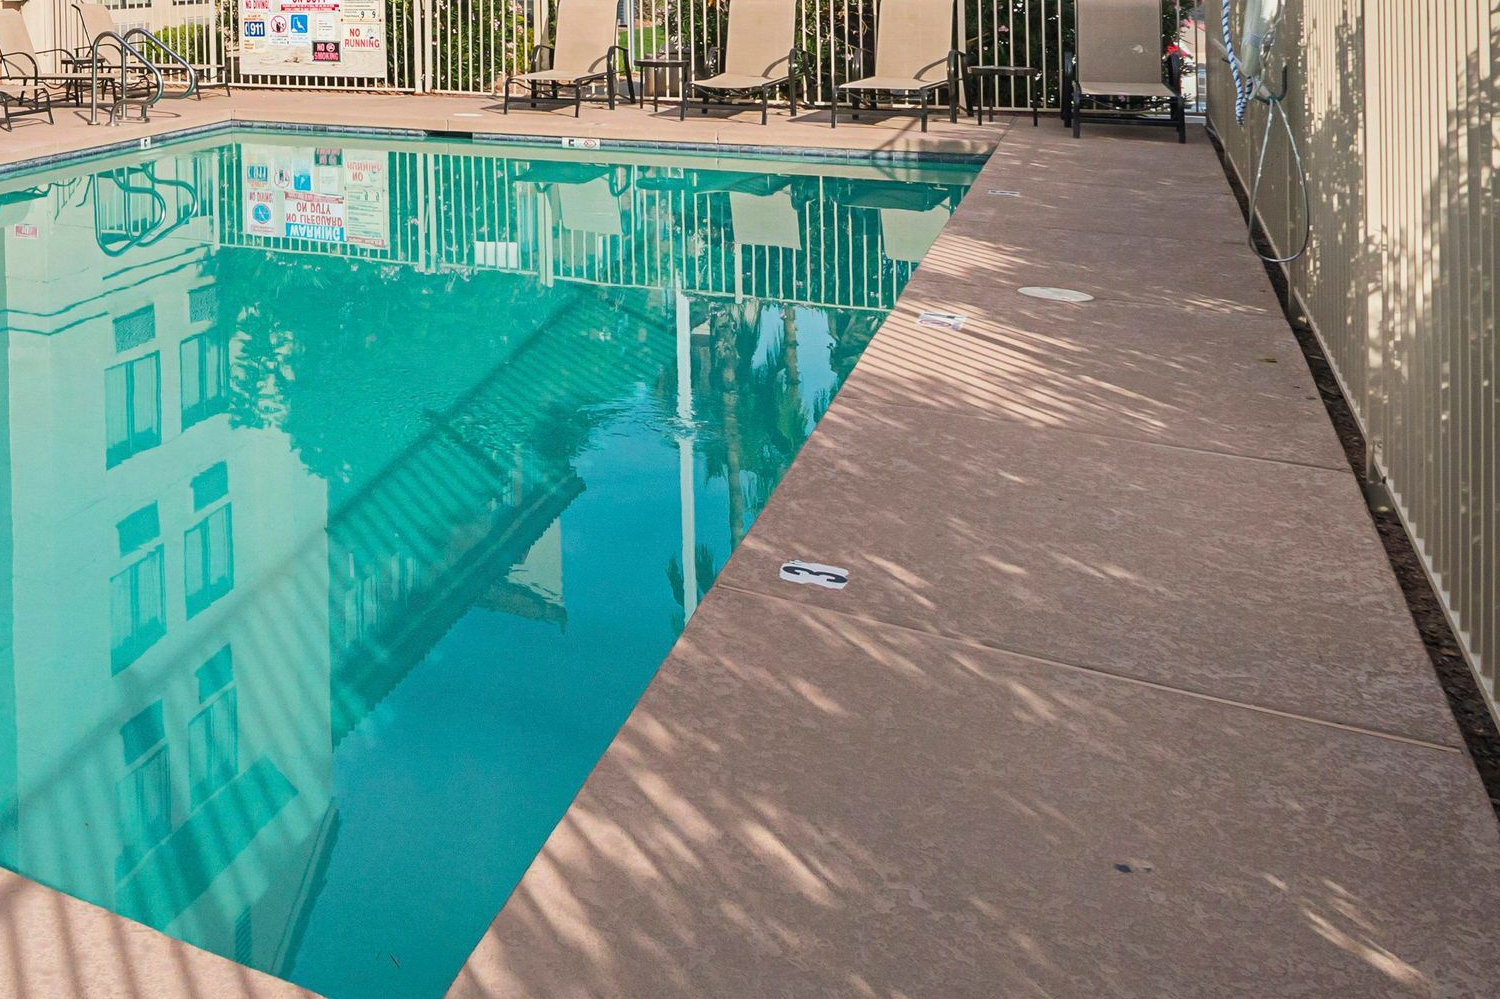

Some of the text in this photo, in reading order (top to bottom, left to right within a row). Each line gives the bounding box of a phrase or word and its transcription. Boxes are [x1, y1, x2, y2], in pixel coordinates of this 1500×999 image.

[245, 0, 252, 9] NO
[250, 22, 264, 35] 911
[349, 28, 361, 37] NO
[316, 43, 325, 51] NO
[345, 39, 380, 48] RUNNING
[314, 52, 339, 60] SMOKING
[782, 566, 848, 583] 3
